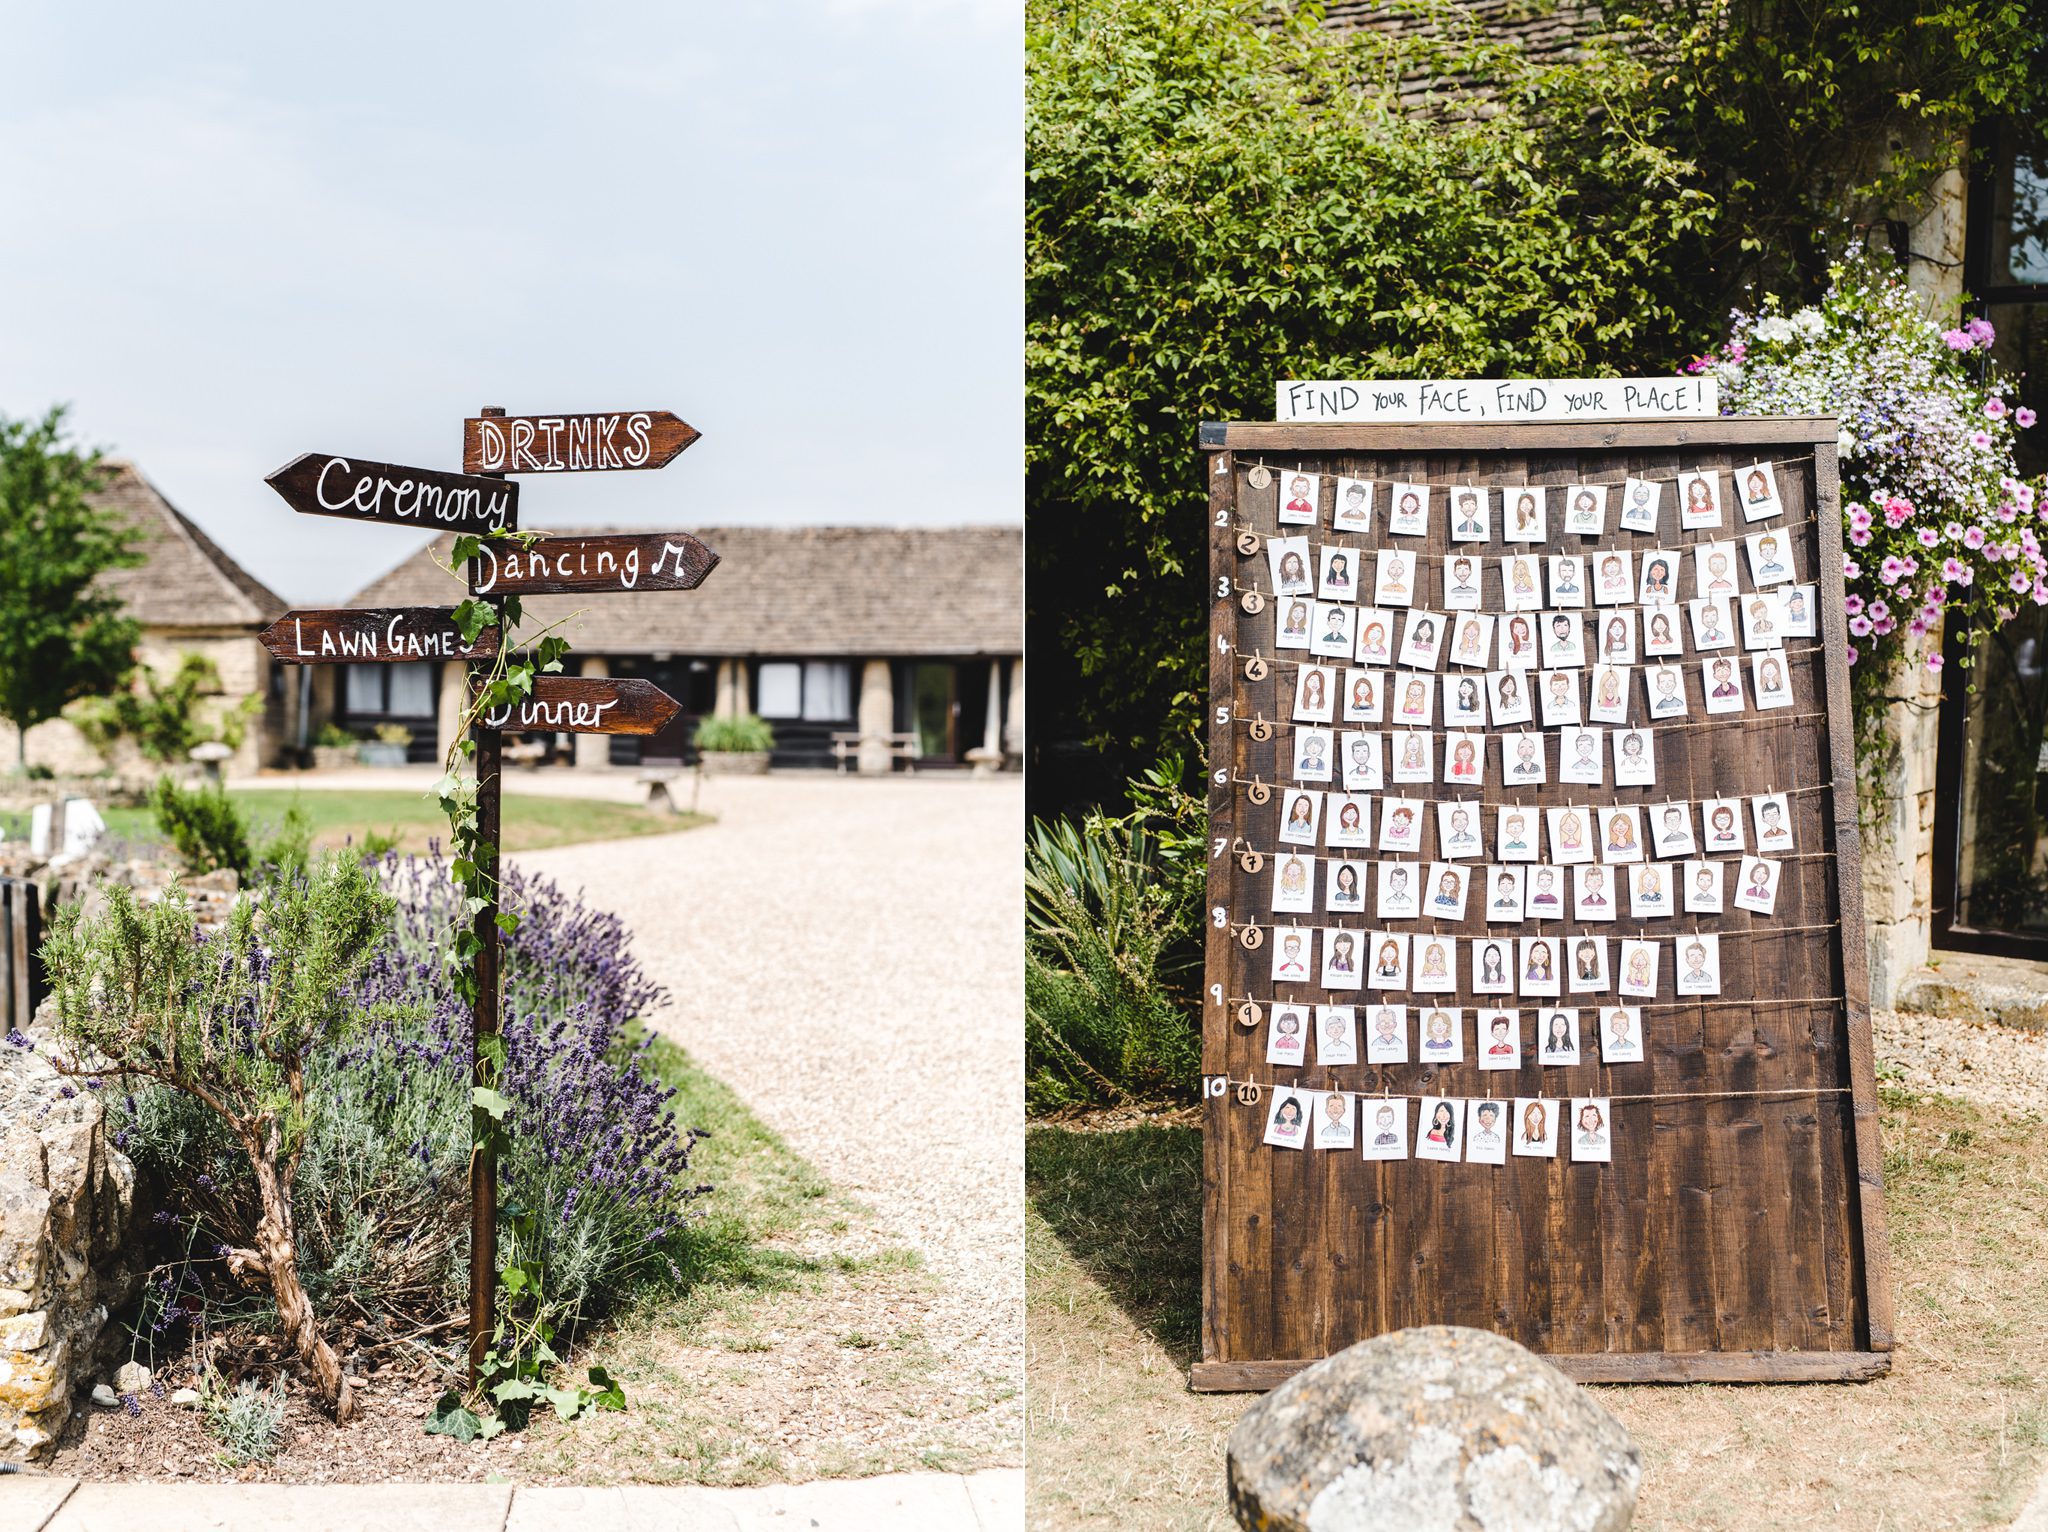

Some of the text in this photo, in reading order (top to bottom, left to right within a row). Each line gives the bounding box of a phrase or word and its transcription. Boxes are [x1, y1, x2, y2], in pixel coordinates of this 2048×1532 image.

[1288, 383, 1359, 417] FIND
[1372, 392, 1408, 412] YOUR
[1496, 383, 1547, 413] FIND
[1564, 391, 1608, 412] YOUR
[480, 412, 653, 471] DRINKS
[1214, 457, 1229, 475] 1
[1252, 468, 1265, 487] 1
[316, 456, 511, 532] Ceremony
[1214, 510, 1229, 527] 2
[1240, 535, 1257, 554] 2
[475, 542, 639, 595] Dancing
[1217, 576, 1230, 598] 3
[1246, 594, 1258, 612] 3
[295, 617, 378, 657] LAWN
[1217, 634, 1230, 655] 4
[1248, 661, 1262, 678] 4
[1215, 706, 1229, 725] 5
[1254, 723, 1266, 739] 5
[1213, 768, 1228, 784] 6
[1252, 786, 1265, 801] 6
[1213, 838, 1228, 859] 7
[1246, 856, 1257, 871] 7
[1212, 907, 1227, 929] 8
[1246, 928, 1257, 946] 8
[1210, 984, 1223, 1007] 9
[1244, 1005, 1252, 1024] 9
[1203, 1077, 1227, 1099] 10
[1241, 1085, 1258, 1102] 10
